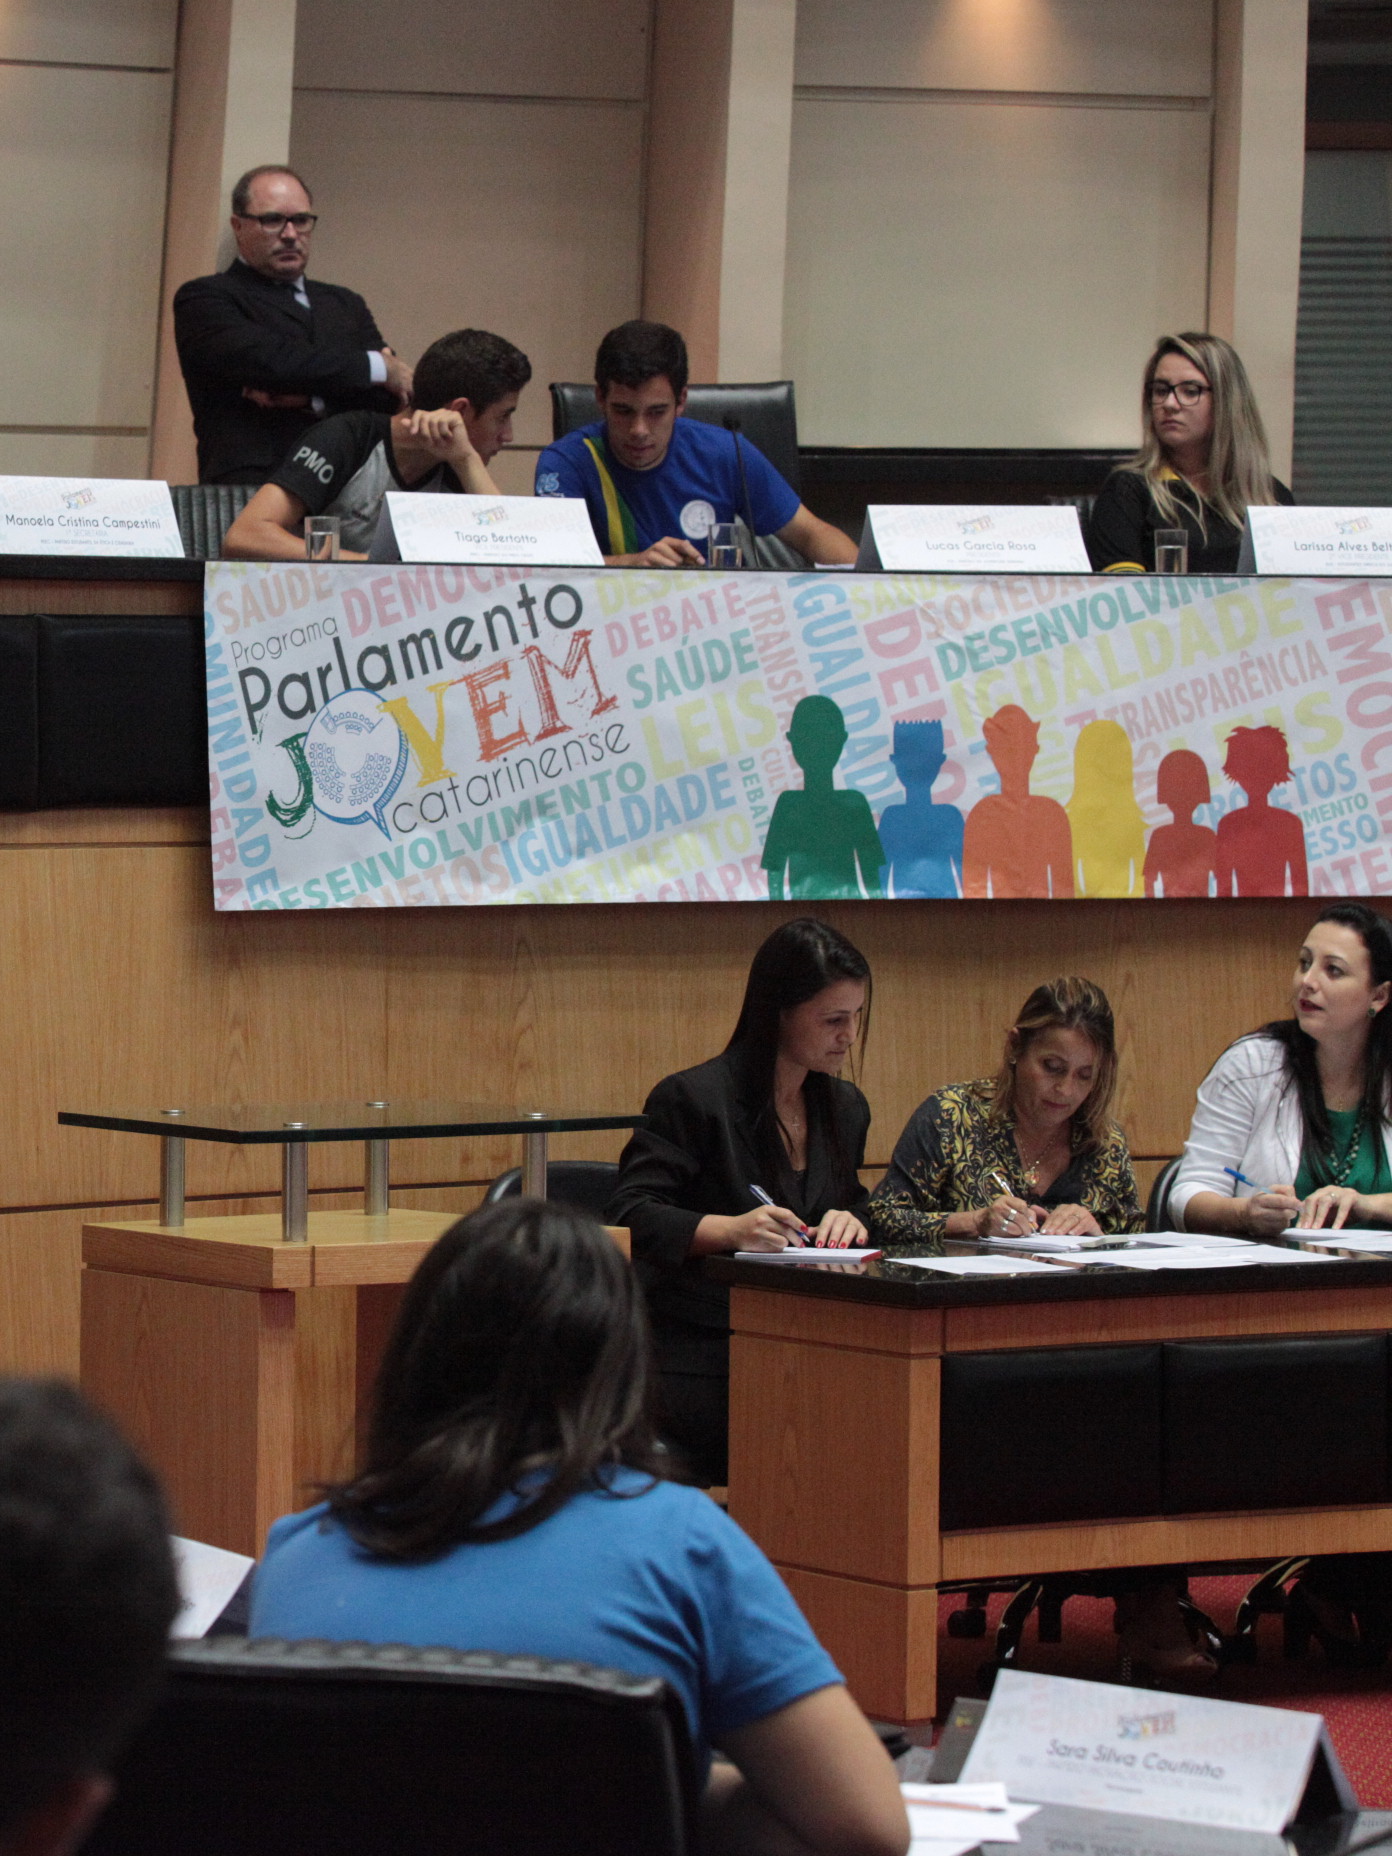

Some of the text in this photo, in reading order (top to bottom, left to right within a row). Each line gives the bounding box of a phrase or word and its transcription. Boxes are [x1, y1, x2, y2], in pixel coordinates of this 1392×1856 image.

[293, 446, 334, 484] PMO
[5, 514, 161, 530] Manoela Cristina Campestini
[454, 531, 537, 544] Tiago Bertotto
[926, 541, 1036, 551] Lucas Garcia Rosa
[1294, 541, 1334, 551] Larissa
[1338, 541, 1368, 551] Alves
[230, 616, 339, 669] Programa
[604, 581, 748, 659] DEBATE
[237, 582, 584, 736] Parlamento
[626, 627, 761, 710] SAÚDE
[640, 679, 778, 782] LEIS
[392, 723, 631, 834] catarinense
[499, 762, 738, 885] IGUALDADE
[1046, 1738, 1087, 1761] Sara
[1092, 1743, 1136, 1769] Silva
[1142, 1752, 1225, 1781] Coutinho
